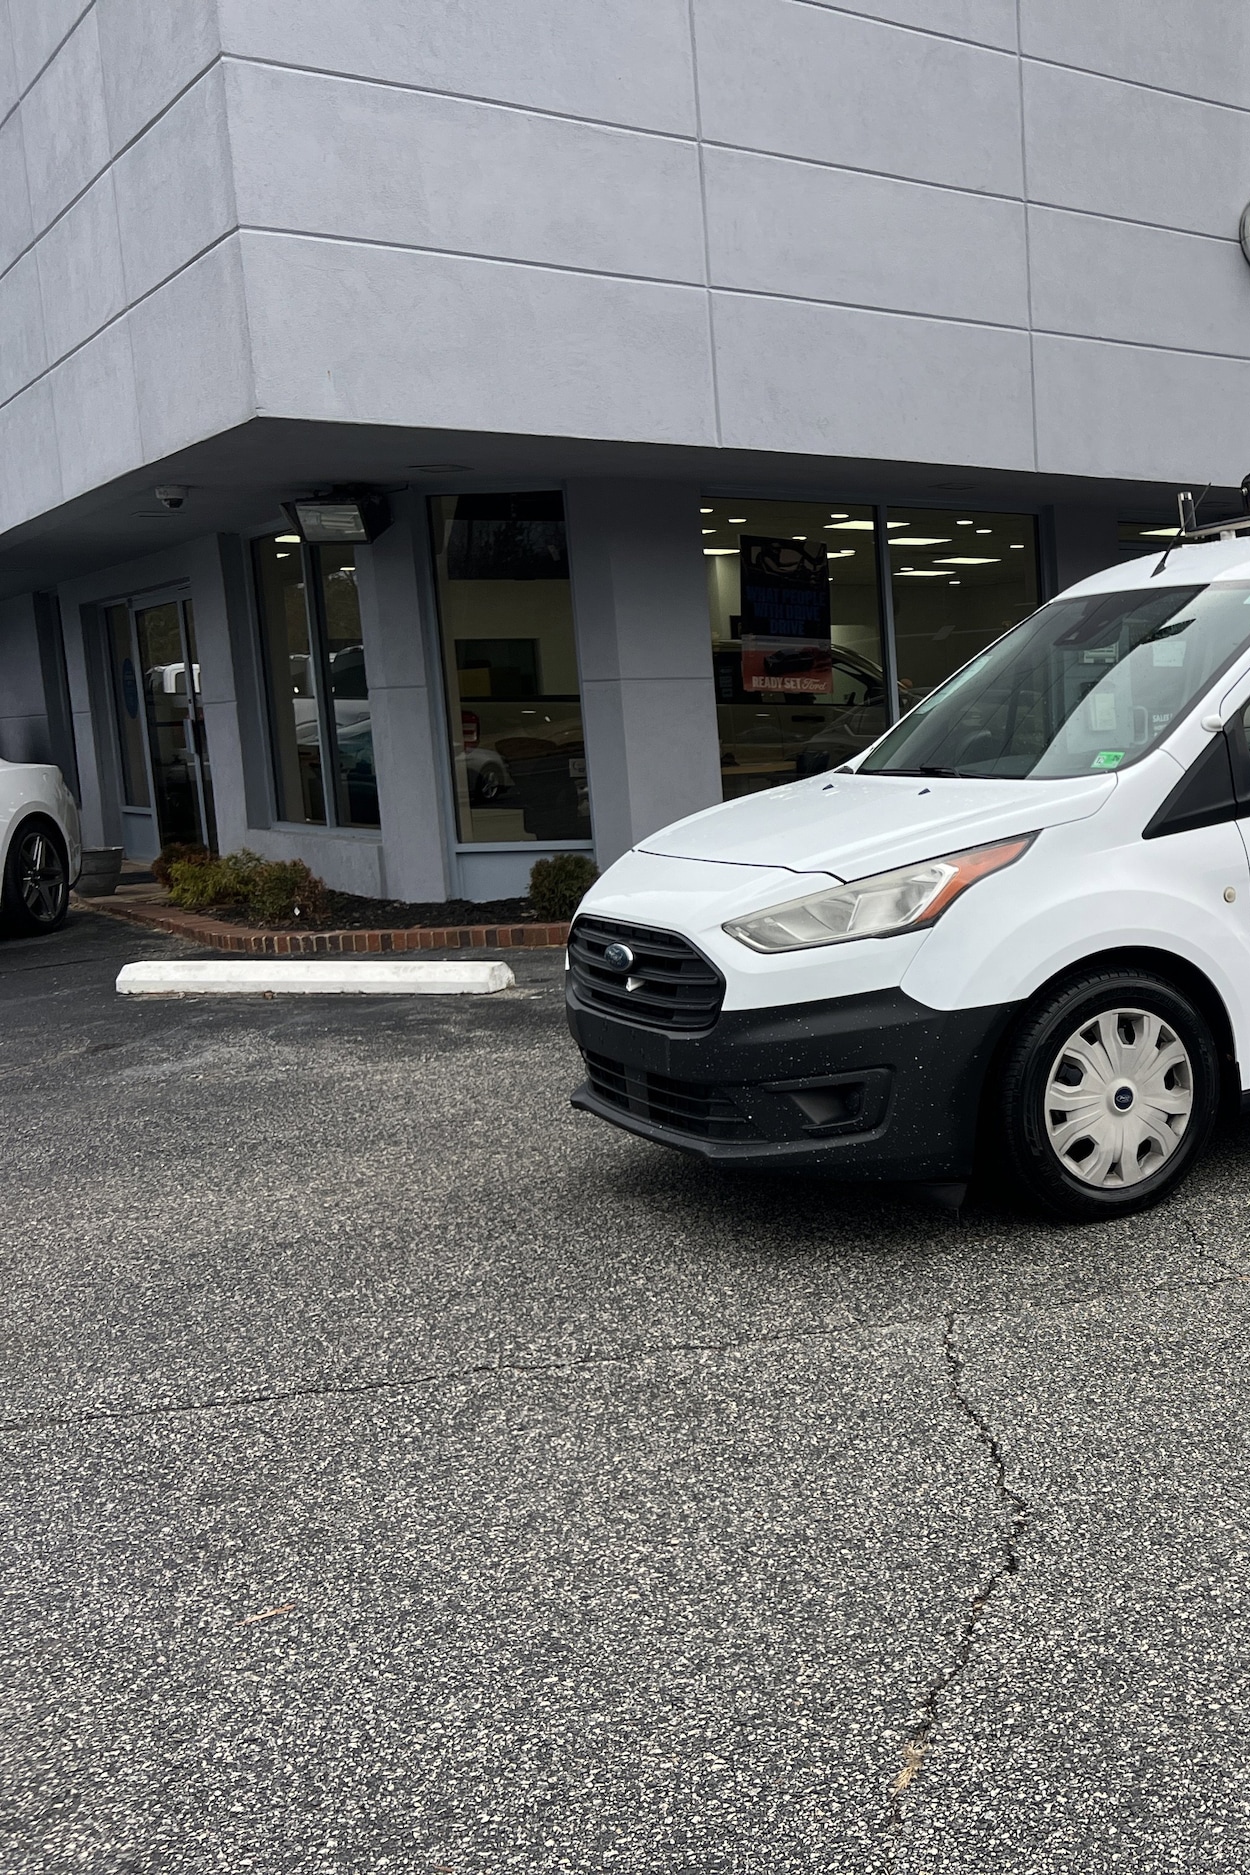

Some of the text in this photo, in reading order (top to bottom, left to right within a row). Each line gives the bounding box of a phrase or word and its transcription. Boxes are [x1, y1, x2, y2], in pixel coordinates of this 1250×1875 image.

[746, 585, 827, 606] WHAT PEOPLE
[754, 602, 821, 621] WITH DRIVE
[769, 618, 805, 635] DRIVE
[752, 676, 827, 691] READY SET Ford
